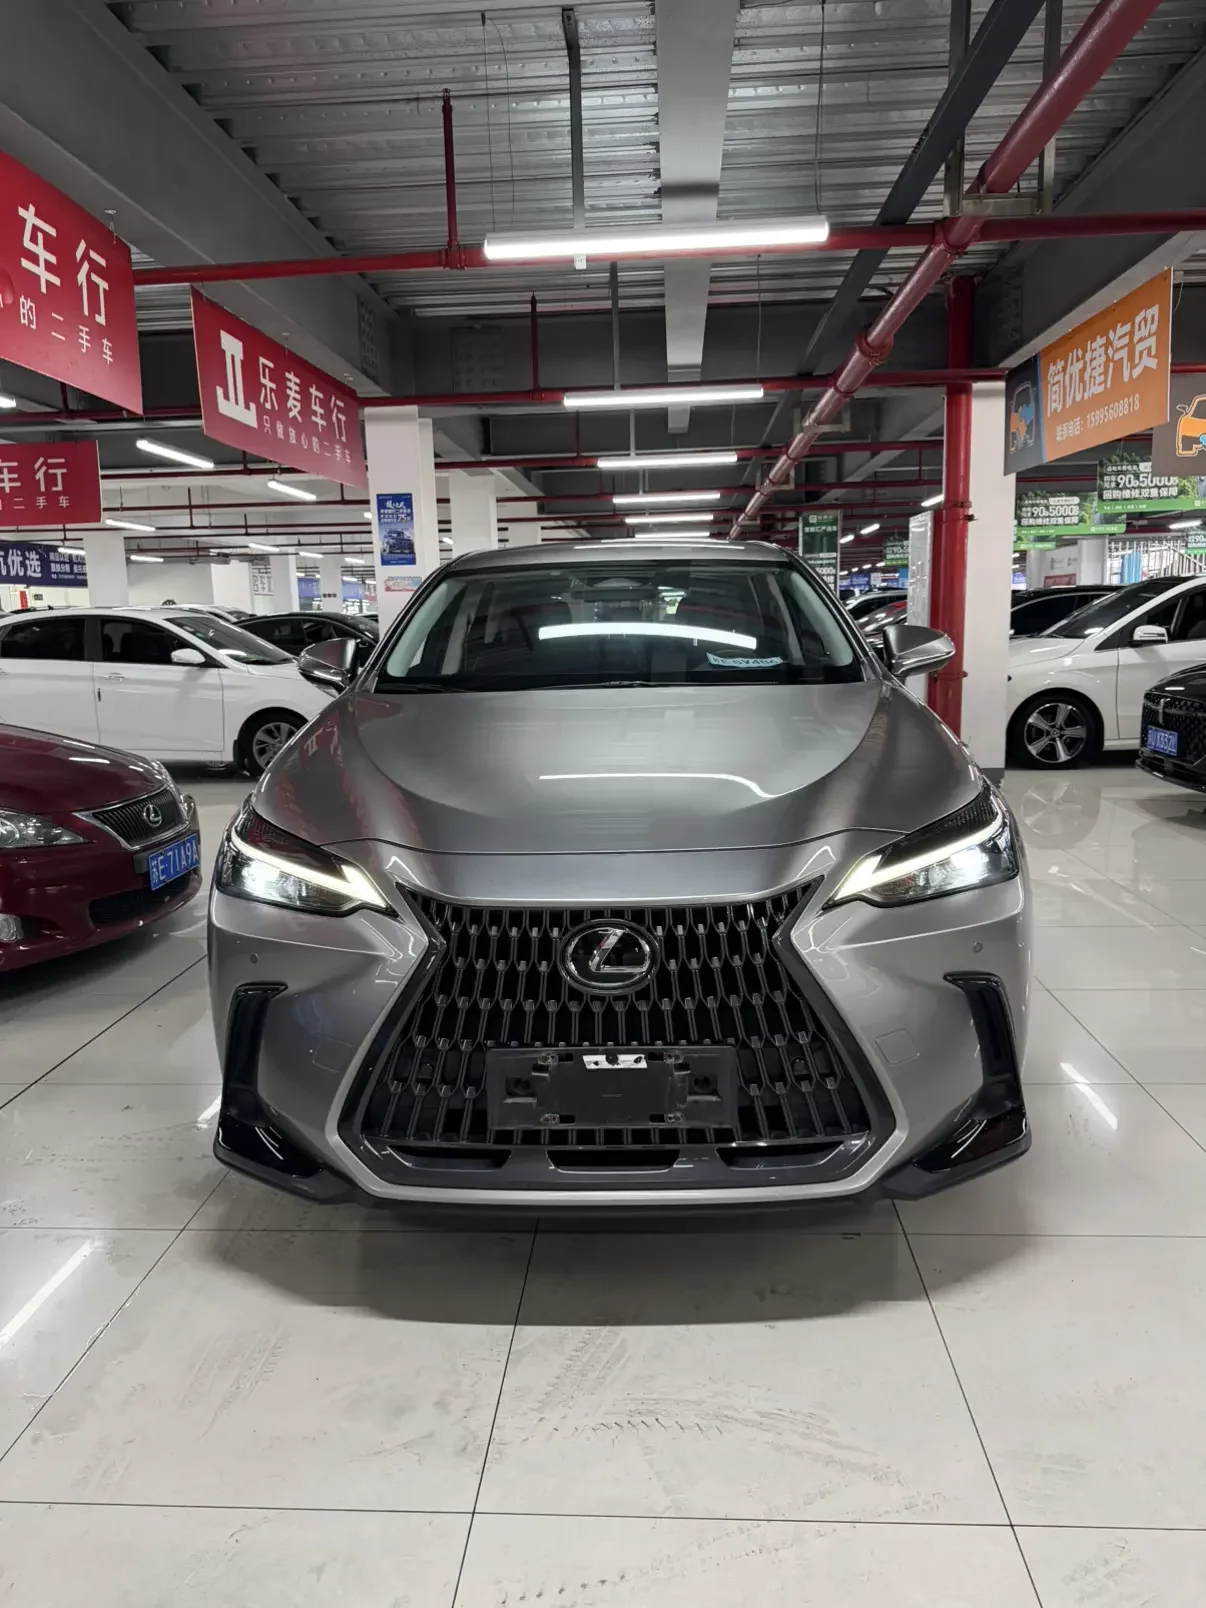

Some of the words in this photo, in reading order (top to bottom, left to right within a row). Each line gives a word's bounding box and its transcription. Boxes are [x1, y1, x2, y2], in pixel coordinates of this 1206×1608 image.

[18, 203, 109, 326] 车行
[0, 293, 113, 364] 的二手车
[1047, 304, 1159, 417] 简优捷汽贸
[258, 356, 346, 442] 乐麦车行
[0, 457, 67, 493] 车行
[263, 415, 351, 464] 只做放心的二手车
[0, 496, 70, 509] 二手车
